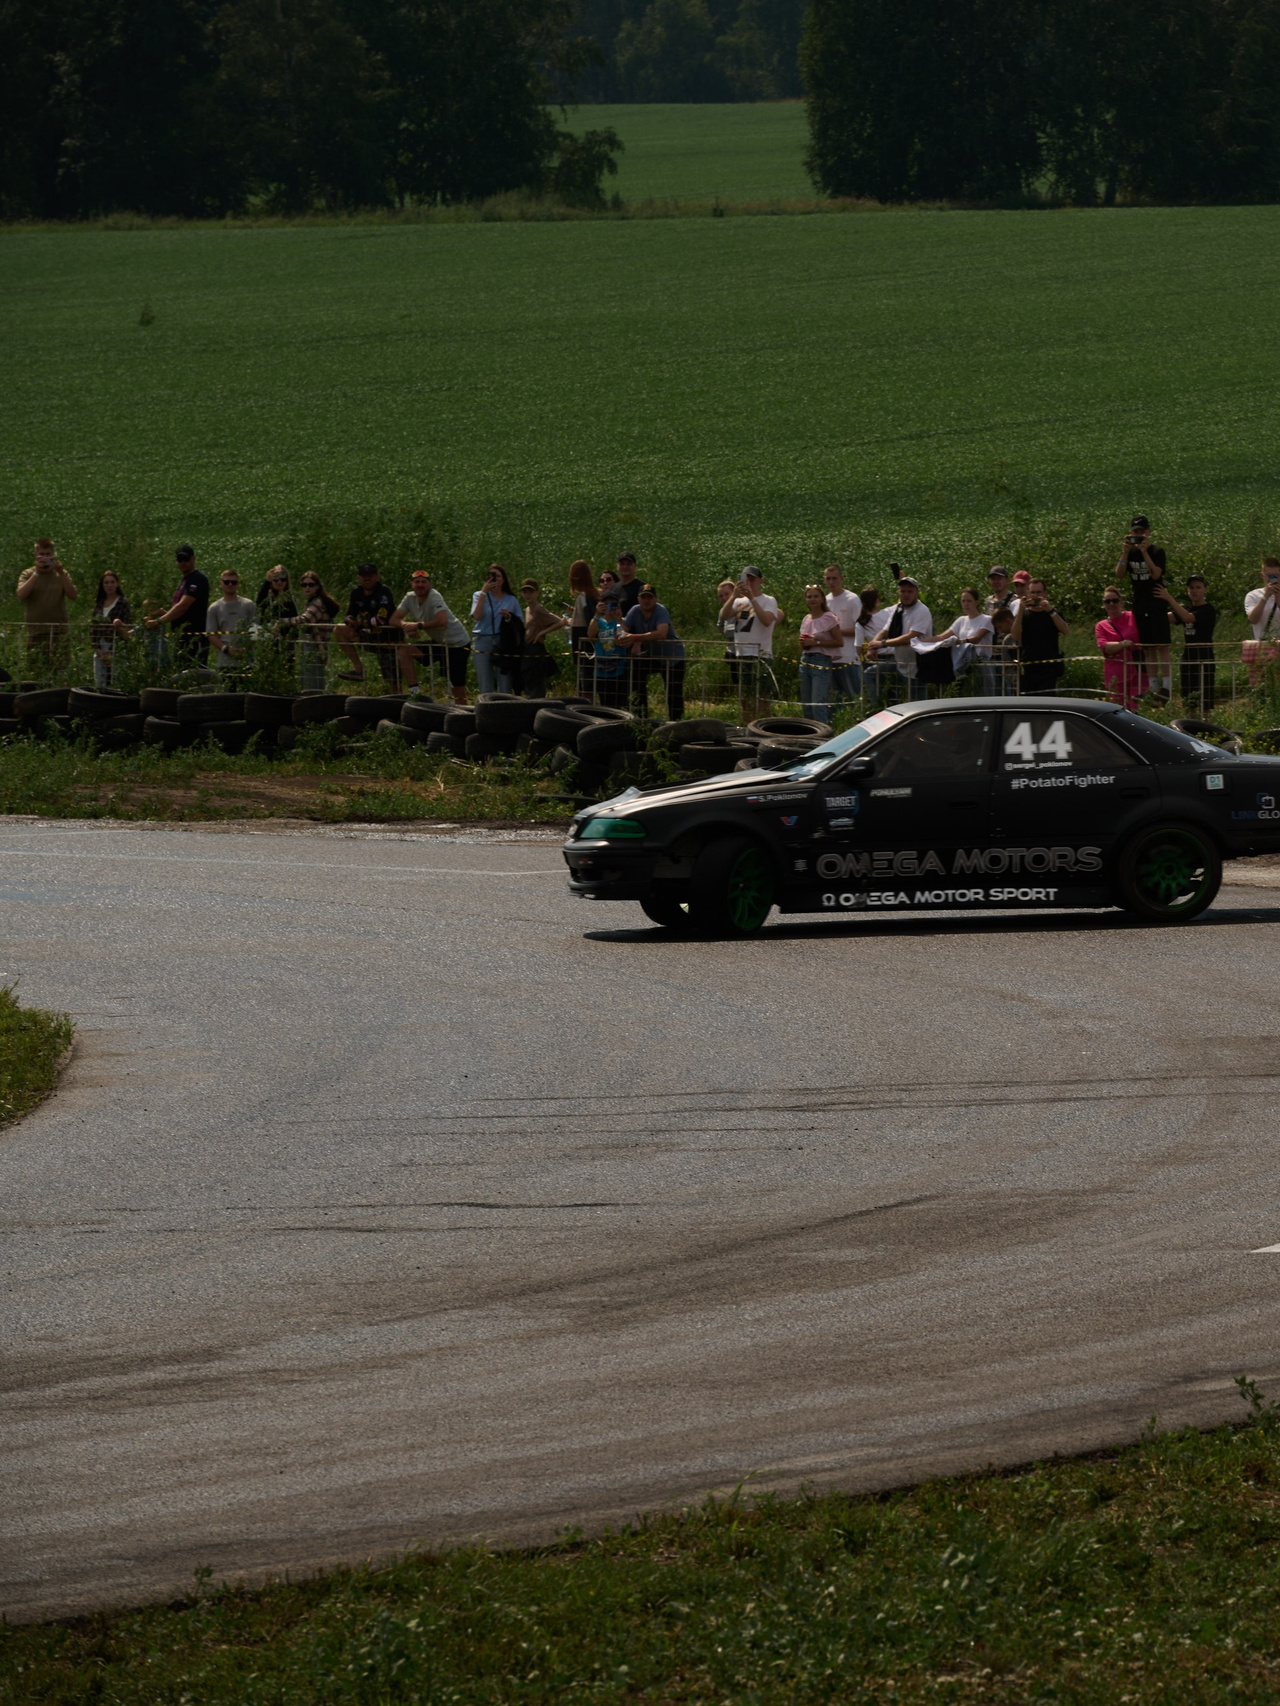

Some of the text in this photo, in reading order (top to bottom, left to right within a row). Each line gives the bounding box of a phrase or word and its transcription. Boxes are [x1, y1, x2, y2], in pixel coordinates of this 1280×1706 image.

[1004, 720, 1073, 761] 44
[1010, 774, 1116, 790] #PotatoFighter
[824, 796, 857, 808] TARGET
[816, 846, 1104, 879] OMEGA MOTORS
[913, 888, 986, 904] MOTOR
[988, 887, 1059, 901] SPORT
